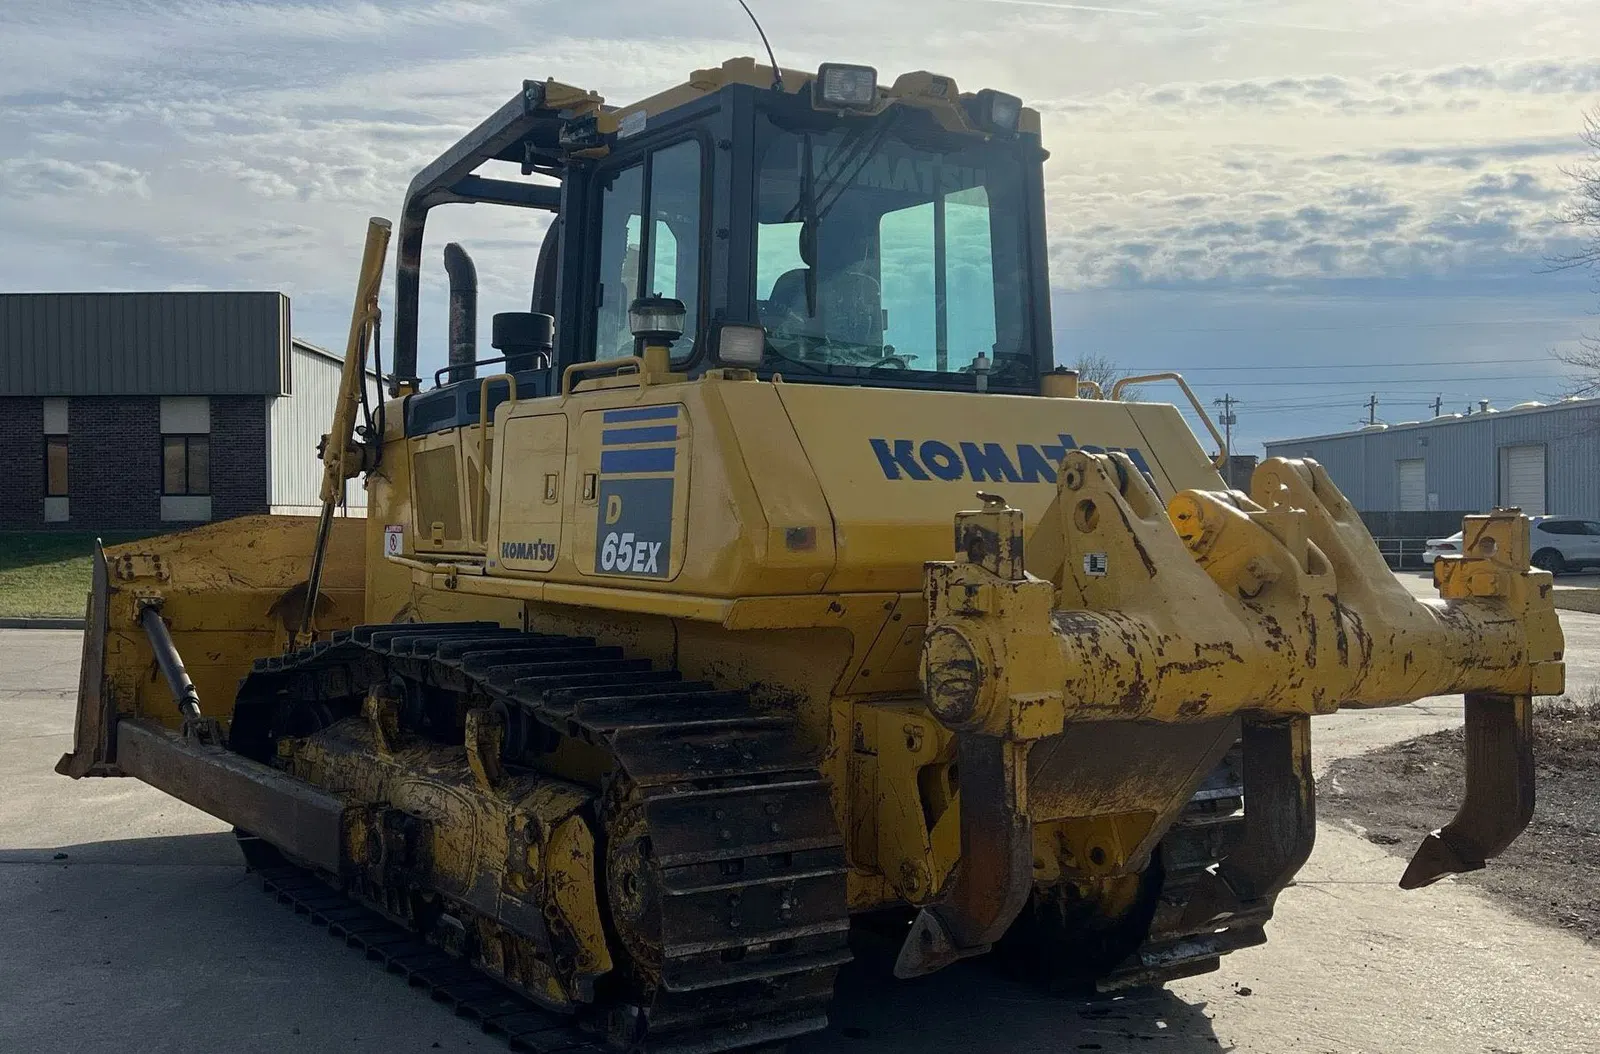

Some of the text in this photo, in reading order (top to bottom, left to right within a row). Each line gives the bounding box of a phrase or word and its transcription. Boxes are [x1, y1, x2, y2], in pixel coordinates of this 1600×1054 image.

[605, 494, 622, 525] D
[502, 538, 555, 561] KOMATSU
[601, 532, 662, 573] 65EX
